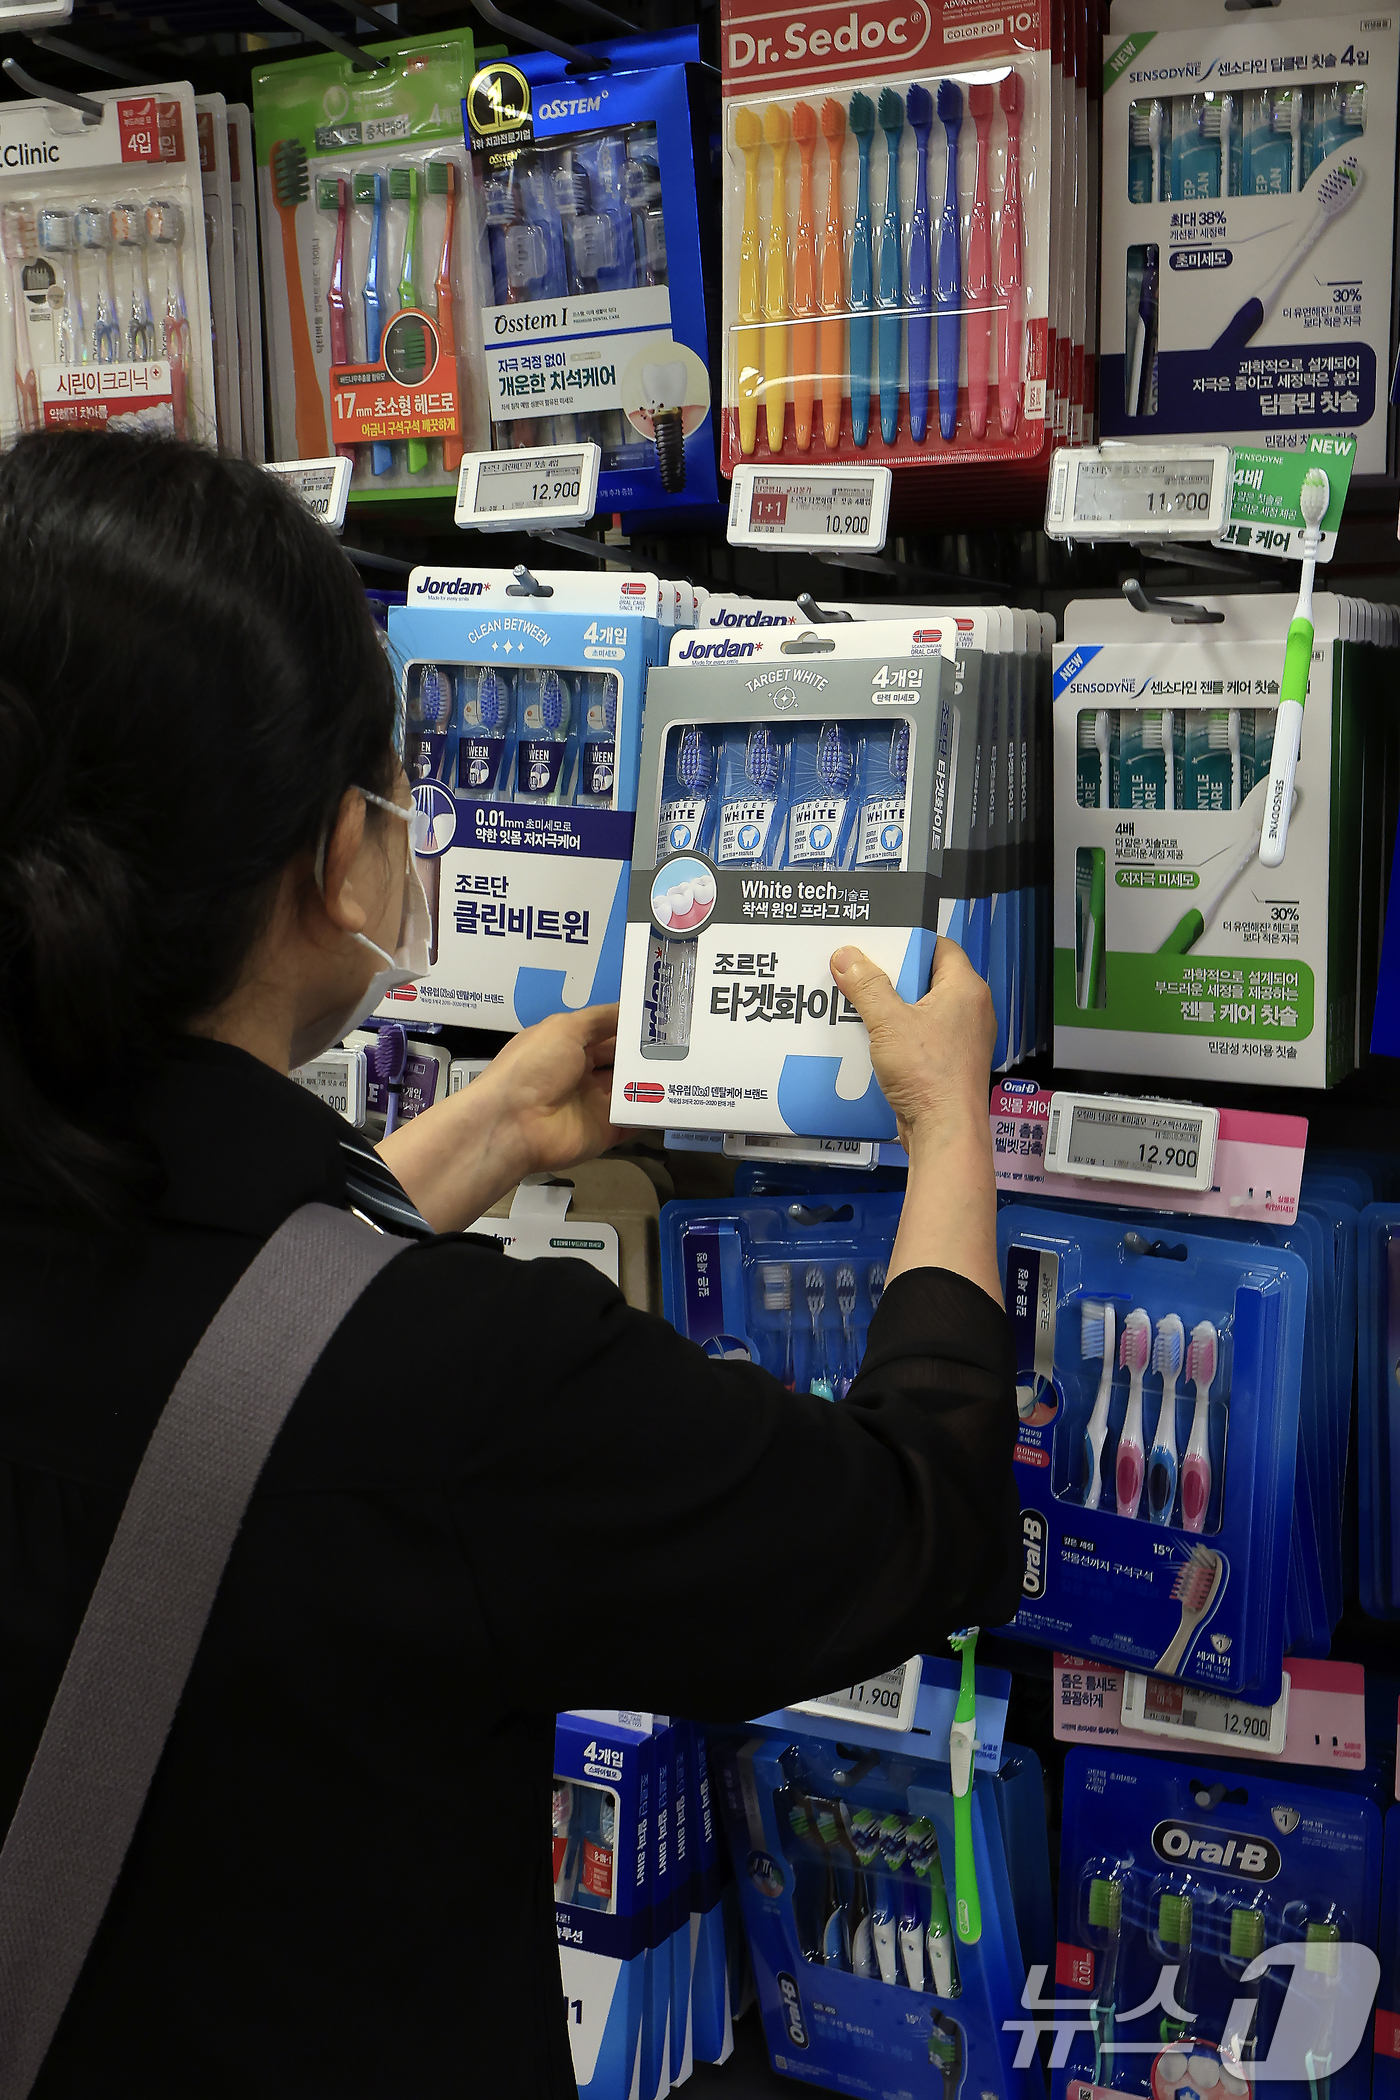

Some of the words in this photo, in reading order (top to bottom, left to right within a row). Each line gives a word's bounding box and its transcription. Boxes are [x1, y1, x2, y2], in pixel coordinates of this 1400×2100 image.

[947, 27, 978, 40] COLOR
[981, 23, 1000, 36] POP
[1007, 12, 1031, 33] 10
[729, 14, 907, 68] Dr.Sedoc
[1111, 41, 1137, 72] NEW
[1129, 65, 1201, 83] SENSODYNE
[1217, 58, 1267, 77] 센소다인
[1270, 55, 1308, 72] 딥클린
[1311, 53, 1337, 70] 칫솔
[1340, 45, 1370, 66] 4입
[538, 96, 601, 121] OSSTEM
[128, 132, 152, 154] 4입
[485, 128, 531, 148] 치과전문기업
[0, 141, 60, 167] .Clinic
[488, 151, 518, 165] OSSTEM
[1170, 212, 1196, 227] 최대
[1198, 211, 1227, 225] 38%
[1175, 252, 1227, 268] 초미세모
[1332, 288, 1362, 303] 30%
[494, 312, 557, 334] Osstem
[1323, 317, 1342, 328] 적은
[1343, 315, 1361, 327] 자극
[498, 358, 518, 373] 자극
[521, 354, 541, 370] 걱정
[544, 352, 567, 367] 없이
[1239, 359, 1303, 375] 과학적으로
[1308, 355, 1360, 372] 설계되어
[56, 367, 149, 396] 시린이크리닉
[498, 371, 546, 397] 개운한
[550, 365, 616, 392] 치석케어
[1192, 377, 1231, 393] 자극은
[1235, 375, 1273, 390] 줄이고
[1277, 373, 1330, 389] 세정력은
[1333, 371, 1360, 386] 높인
[49, 406, 78, 421] 약해진
[80, 404, 108, 420] 치아를
[334, 392, 373, 419] 17mm
[374, 394, 411, 417] 초소형
[414, 392, 455, 414] 헤드로
[1260, 392, 1315, 416] 딥클린
[1320, 390, 1359, 413] 칫솔
[361, 423, 386, 436] 어금니
[387, 420, 420, 434] 구석구석
[422, 417, 456, 432] 깨끗하게
[1265, 434, 1297, 448] 민감성
[1310, 439, 1352, 456] NEW
[1234, 469, 1264, 490] 4배
[532, 481, 580, 501] 12,900
[757, 501, 781, 517] 1+1
[826, 515, 868, 534] 10,900
[1255, 530, 1291, 552] 케어
[416, 576, 483, 595] Jordan
[710, 609, 787, 626] Jordan
[468, 618, 501, 645] CLEAN
[503, 618, 552, 647] BETWEEN
[583, 622, 627, 646] 4개입
[592, 649, 618, 658] 초미세모
[679, 639, 754, 659] Jordan
[871, 666, 924, 688] 4개입
[1059, 654, 1084, 681] NEW
[745, 669, 791, 693] TARGET
[792, 668, 829, 692] WHITE
[1070, 681, 1135, 694] SENSODYNE
[1150, 680, 1197, 696] 센소다인
[1200, 681, 1224, 695] 젠틀
[1227, 680, 1251, 694] 케어
[1254, 680, 1279, 695] 칫솔
[876, 693, 891, 702] 탄력
[893, 693, 915, 702] 미세모
[724, 802, 768, 812] TARGET
[796, 802, 839, 812] TARGET
[932, 759, 946, 850] 타겟화이트
[1269, 780, 1283, 839] SENSODYNE
[476, 808, 524, 829] 0.01mm
[526, 819, 572, 832] 초미세모로
[724, 810, 765, 823] WHITE
[796, 809, 836, 823] WHITE
[867, 809, 905, 823] WHITE
[476, 828, 497, 844] 약한
[499, 830, 522, 846] 잇몸
[524, 832, 581, 850] 저자극케어
[1115, 822, 1135, 836] 4배
[1145, 838, 1178, 849] 칫솔모로
[1115, 849, 1147, 860] 부드러운
[1149, 849, 1165, 860] 세정
[1167, 849, 1183, 860] 제공
[454, 873, 509, 899] 조르단
[1121, 872, 1155, 886] 저자극
[1159, 873, 1194, 887] 미세모
[741, 881, 793, 899] White
[742, 901, 768, 918] 착색
[771, 901, 798, 919] 원인
[800, 903, 840, 919] 프라그
[842, 904, 870, 921] 제거
[1271, 908, 1299, 921] 30%
[453, 900, 590, 945] 클린비트윈
[1223, 922, 1233, 931] 더
[1273, 923, 1299, 933] 헤드로
[1243, 933, 1260, 942] 보다
[1262, 933, 1279, 943] 적은
[1281, 934, 1298, 944] 자극
[712, 952, 778, 978] 조르단
[1182, 968, 1244, 983] 과학적으로
[1249, 971, 1298, 987] 설계되어
[420, 986, 439, 997] 북유럽
[456, 990, 482, 1002] 덴탈케어
[484, 993, 504, 1004] 브랜드
[1155, 981, 1203, 996] 부드러운
[1207, 983, 1244, 999] 세정을
[1249, 985, 1299, 1001] 제공하는
[1180, 1001, 1216, 1022] 젠틀
[1219, 1004, 1256, 1024] 케어
[1261, 1007, 1298, 1027] 칫솔
[1208, 1041, 1239, 1056] 민감성
[1242, 1043, 1274, 1058] 치아용
[1277, 1044, 1298, 1059] 칫솔
[668, 1084, 691, 1096] 북유럽
[692, 1086, 709, 1097] No.1
[711, 1087, 742, 1099] 덴탈케어
[744, 1089, 768, 1099] 브랜드
[1004, 1082, 1035, 1093] Oral-B
[1000, 1097, 1023, 1113] 잇몸
[1026, 1100, 1050, 1117] 케어
[996, 1121, 1015, 1137] 2배
[995, 1138, 1043, 1156] 벨벳감촉
[1139, 1144, 1197, 1168] 12,900
[696, 1253, 708, 1273] 세정
[1018, 1268, 1029, 1292] 세정
[1016, 1295, 1027, 1317] 깊은
[1023, 1517, 1042, 1593] Oral-B
[1061, 1550, 1110, 1572] 잇몸선까지
[1113, 1563, 1154, 1582] 구석구석
[1196, 1651, 1215, 1664] 세계
[1218, 1654, 1231, 1667] 1위
[1061, 1673, 1082, 1689] 좁은
[849, 1684, 900, 1709] 11,900
[1061, 1690, 1103, 1708] 꼼꼼하게
[1224, 1712, 1267, 1737] 12,900
[584, 1741, 623, 1768] 4개입
[703, 1810, 712, 1842] 8IN1
[678, 1827, 686, 1860] 8IN1
[1162, 1829, 1267, 1873] Oral-B
[659, 1842, 667, 1875] 8IN1
[636, 1854, 645, 1886] 8IN1
[780, 1978, 805, 2044] Oral-B
